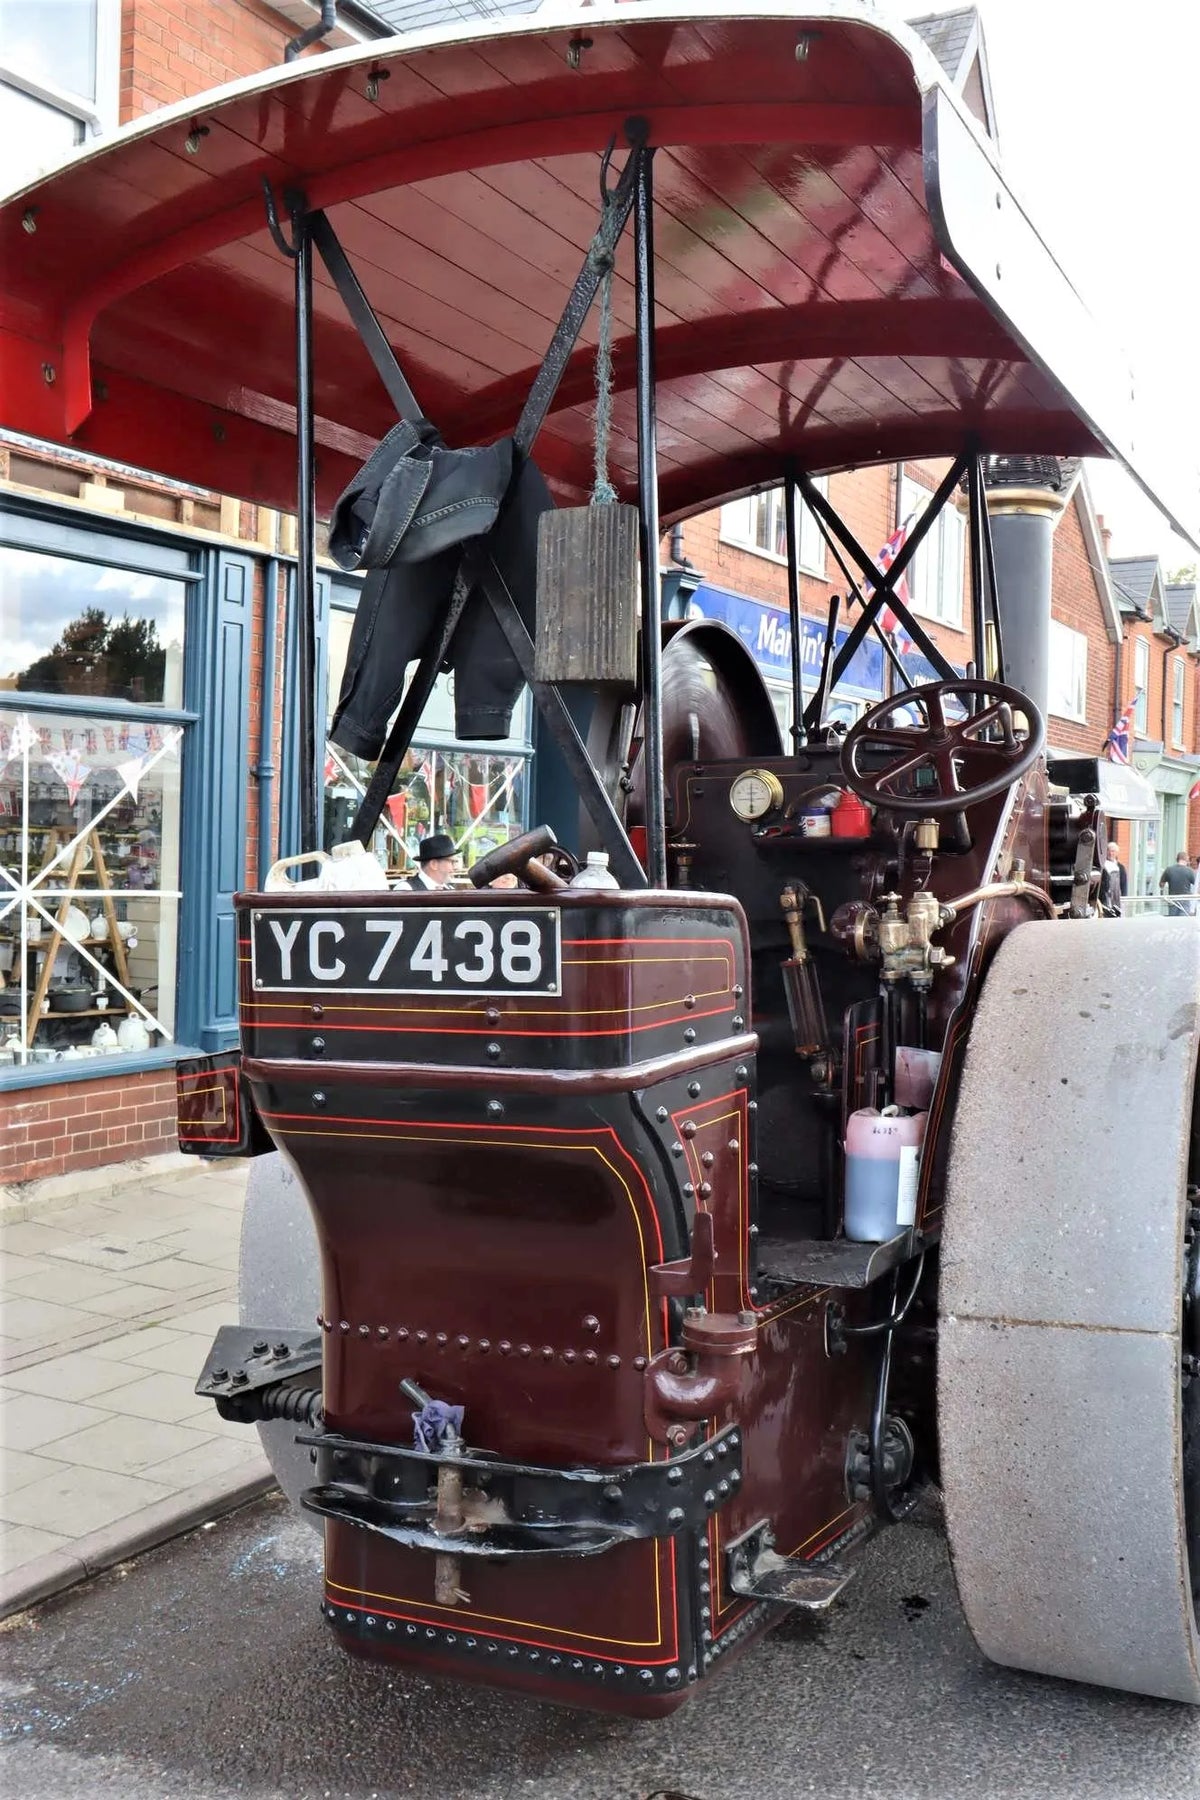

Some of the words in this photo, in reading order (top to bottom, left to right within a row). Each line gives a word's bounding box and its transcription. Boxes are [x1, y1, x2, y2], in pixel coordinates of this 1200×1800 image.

[757, 614, 826, 667] Marin's
[269, 920, 346, 981] YC
[365, 919, 542, 983] 7438
